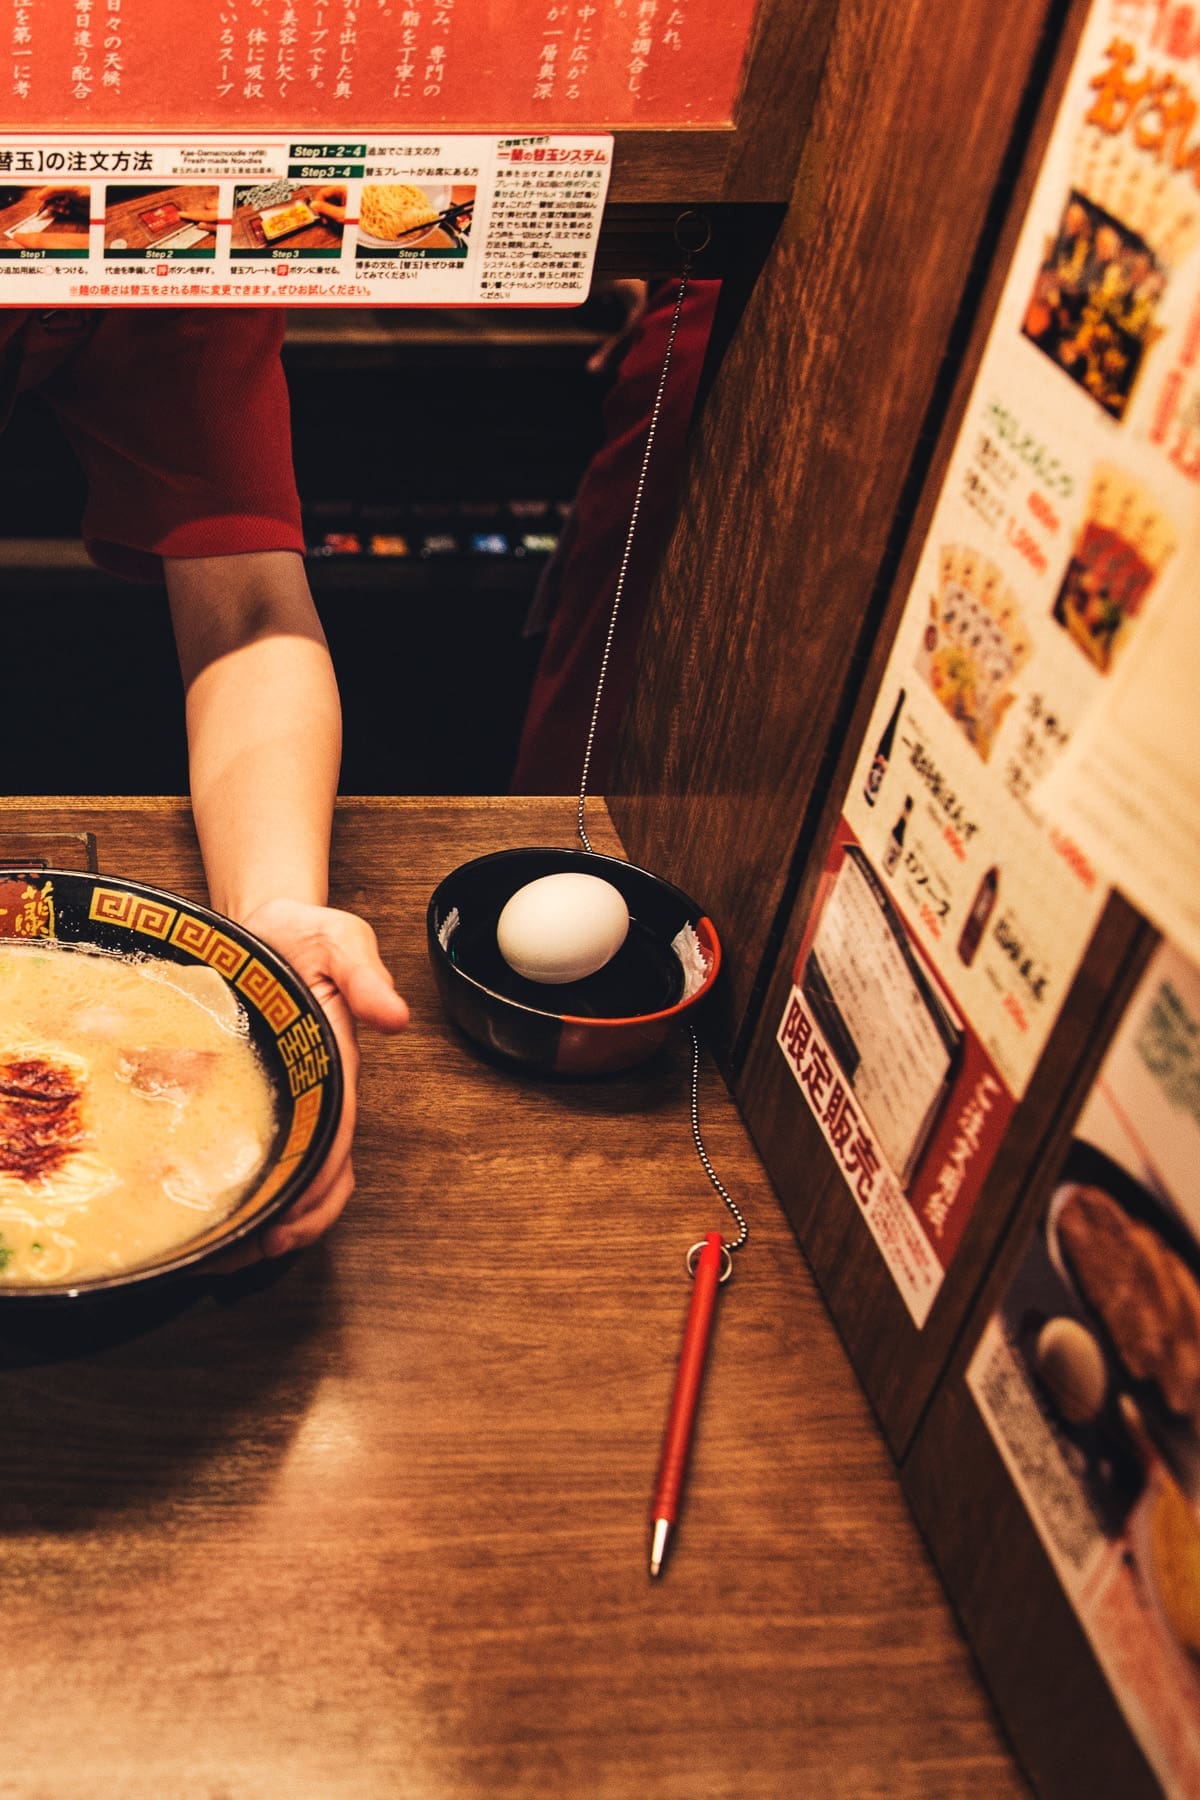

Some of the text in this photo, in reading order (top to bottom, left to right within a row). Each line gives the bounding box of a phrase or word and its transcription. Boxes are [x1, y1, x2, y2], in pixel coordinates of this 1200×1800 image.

[661, 0, 688, 52] たれ。
[779, 998, 882, 1206] 限定販売
